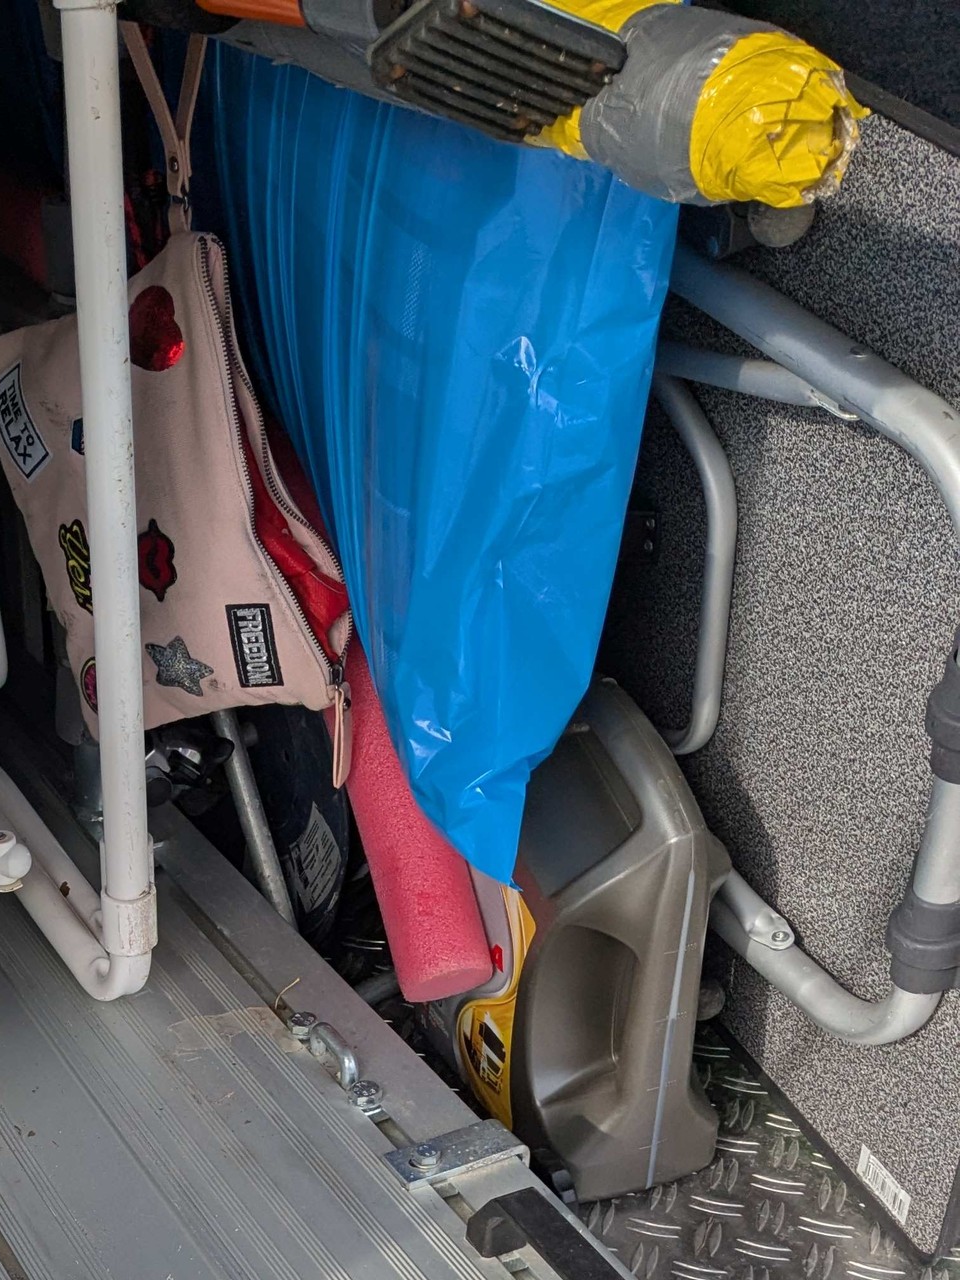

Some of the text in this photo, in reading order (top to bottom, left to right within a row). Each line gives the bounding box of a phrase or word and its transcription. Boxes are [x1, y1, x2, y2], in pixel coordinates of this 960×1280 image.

[7, 379, 35, 447] TIME TO
[237, 607, 273, 686] FREEDOM
